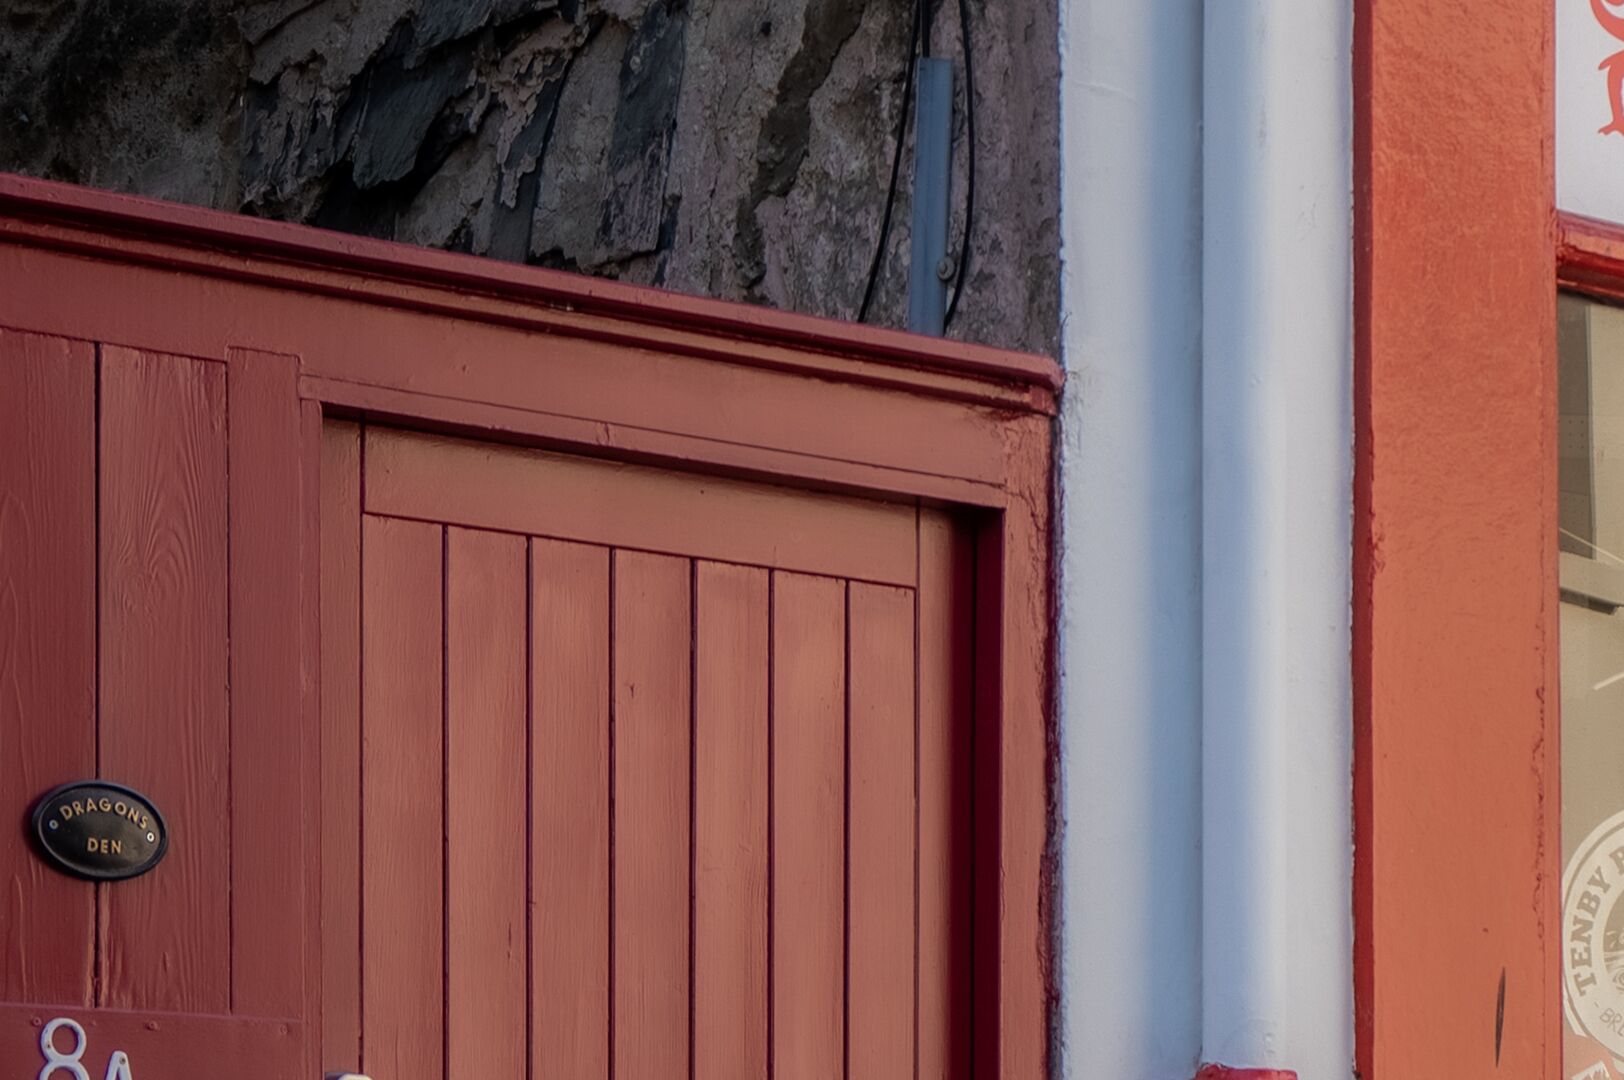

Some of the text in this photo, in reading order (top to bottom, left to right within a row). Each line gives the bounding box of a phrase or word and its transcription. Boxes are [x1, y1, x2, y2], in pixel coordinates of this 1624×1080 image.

[59, 797, 149, 829] DRAGONS
[86, 837, 122, 854] DEN
[1571, 866, 1611, 996] TENBY
